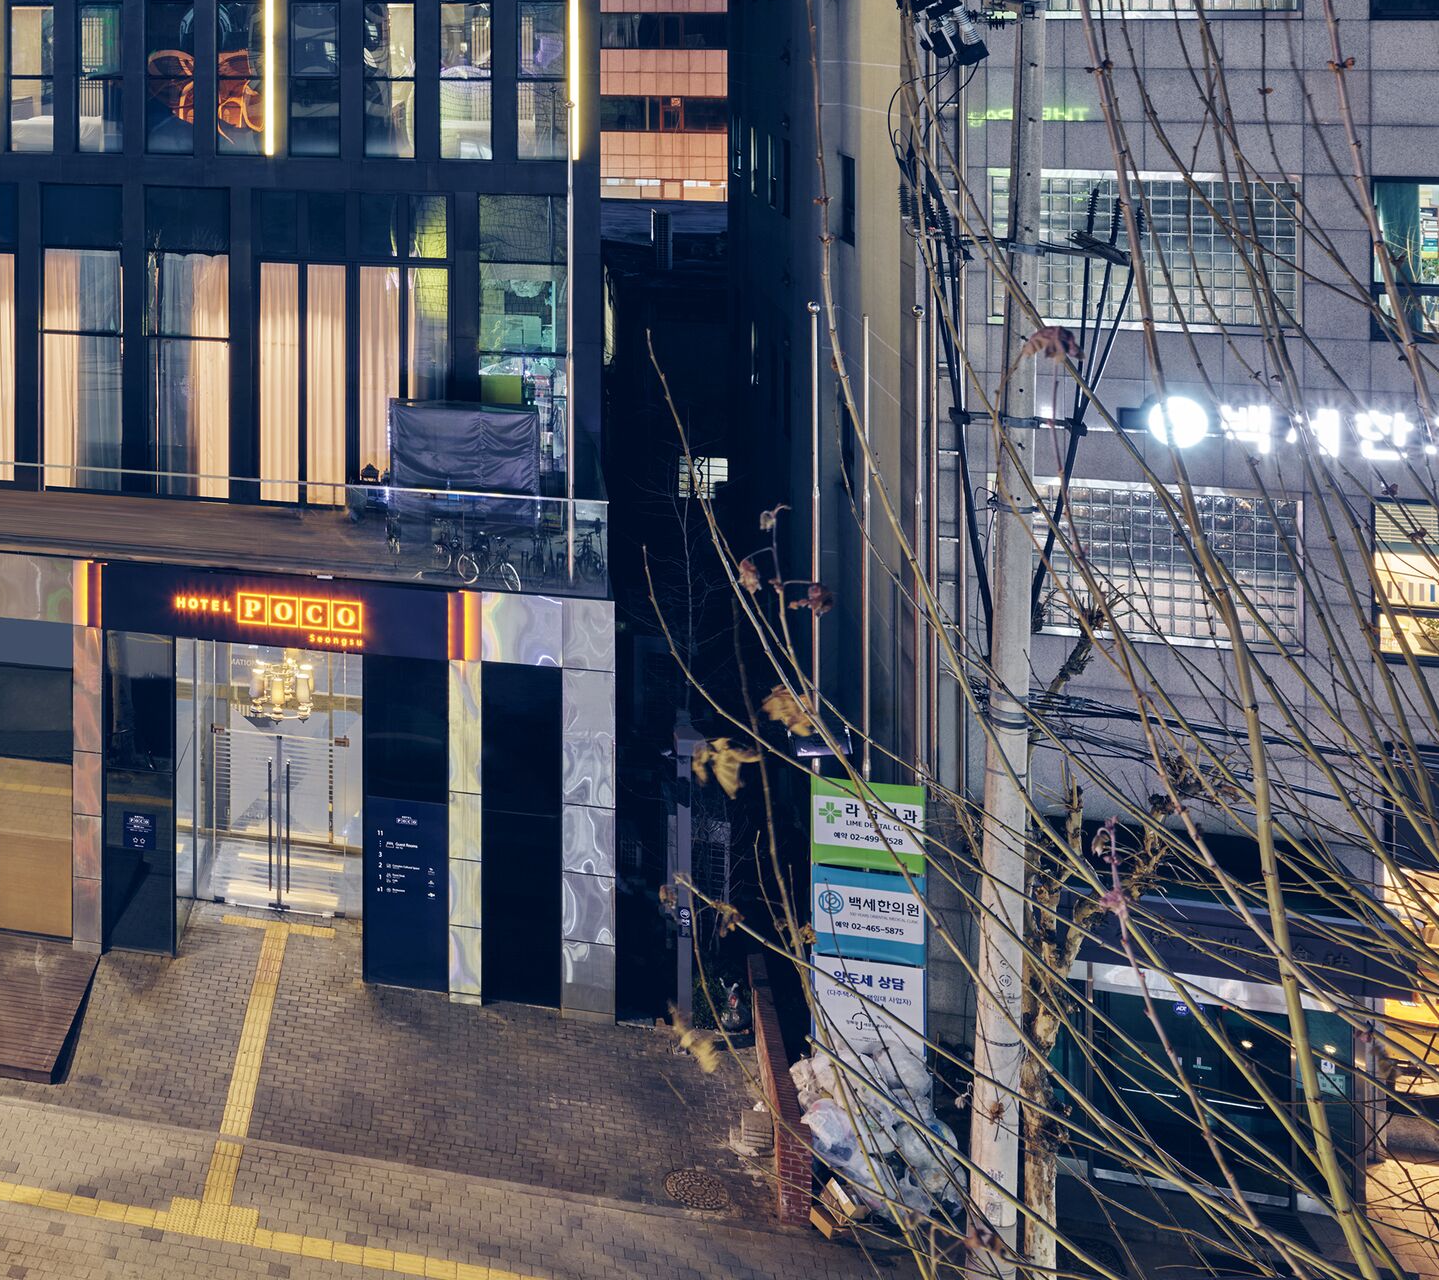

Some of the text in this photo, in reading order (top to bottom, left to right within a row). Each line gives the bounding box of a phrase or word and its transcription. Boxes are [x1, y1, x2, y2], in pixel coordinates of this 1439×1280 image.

[175, 596, 356, 627] HOTEL POCO
[309, 633, 363, 647] Seongsu
[846, 820, 863, 828] LIME
[864, 822, 892, 831] DETAL
[377, 829, 384, 837] 11
[834, 831, 848, 839] 예약
[848, 896, 919, 918] 백세한의원
[835, 921, 904, 936] 예약 02-465-5875
[833, 970, 905, 991] 양도세 상담
[889, 996, 912, 1006] 사업자)
